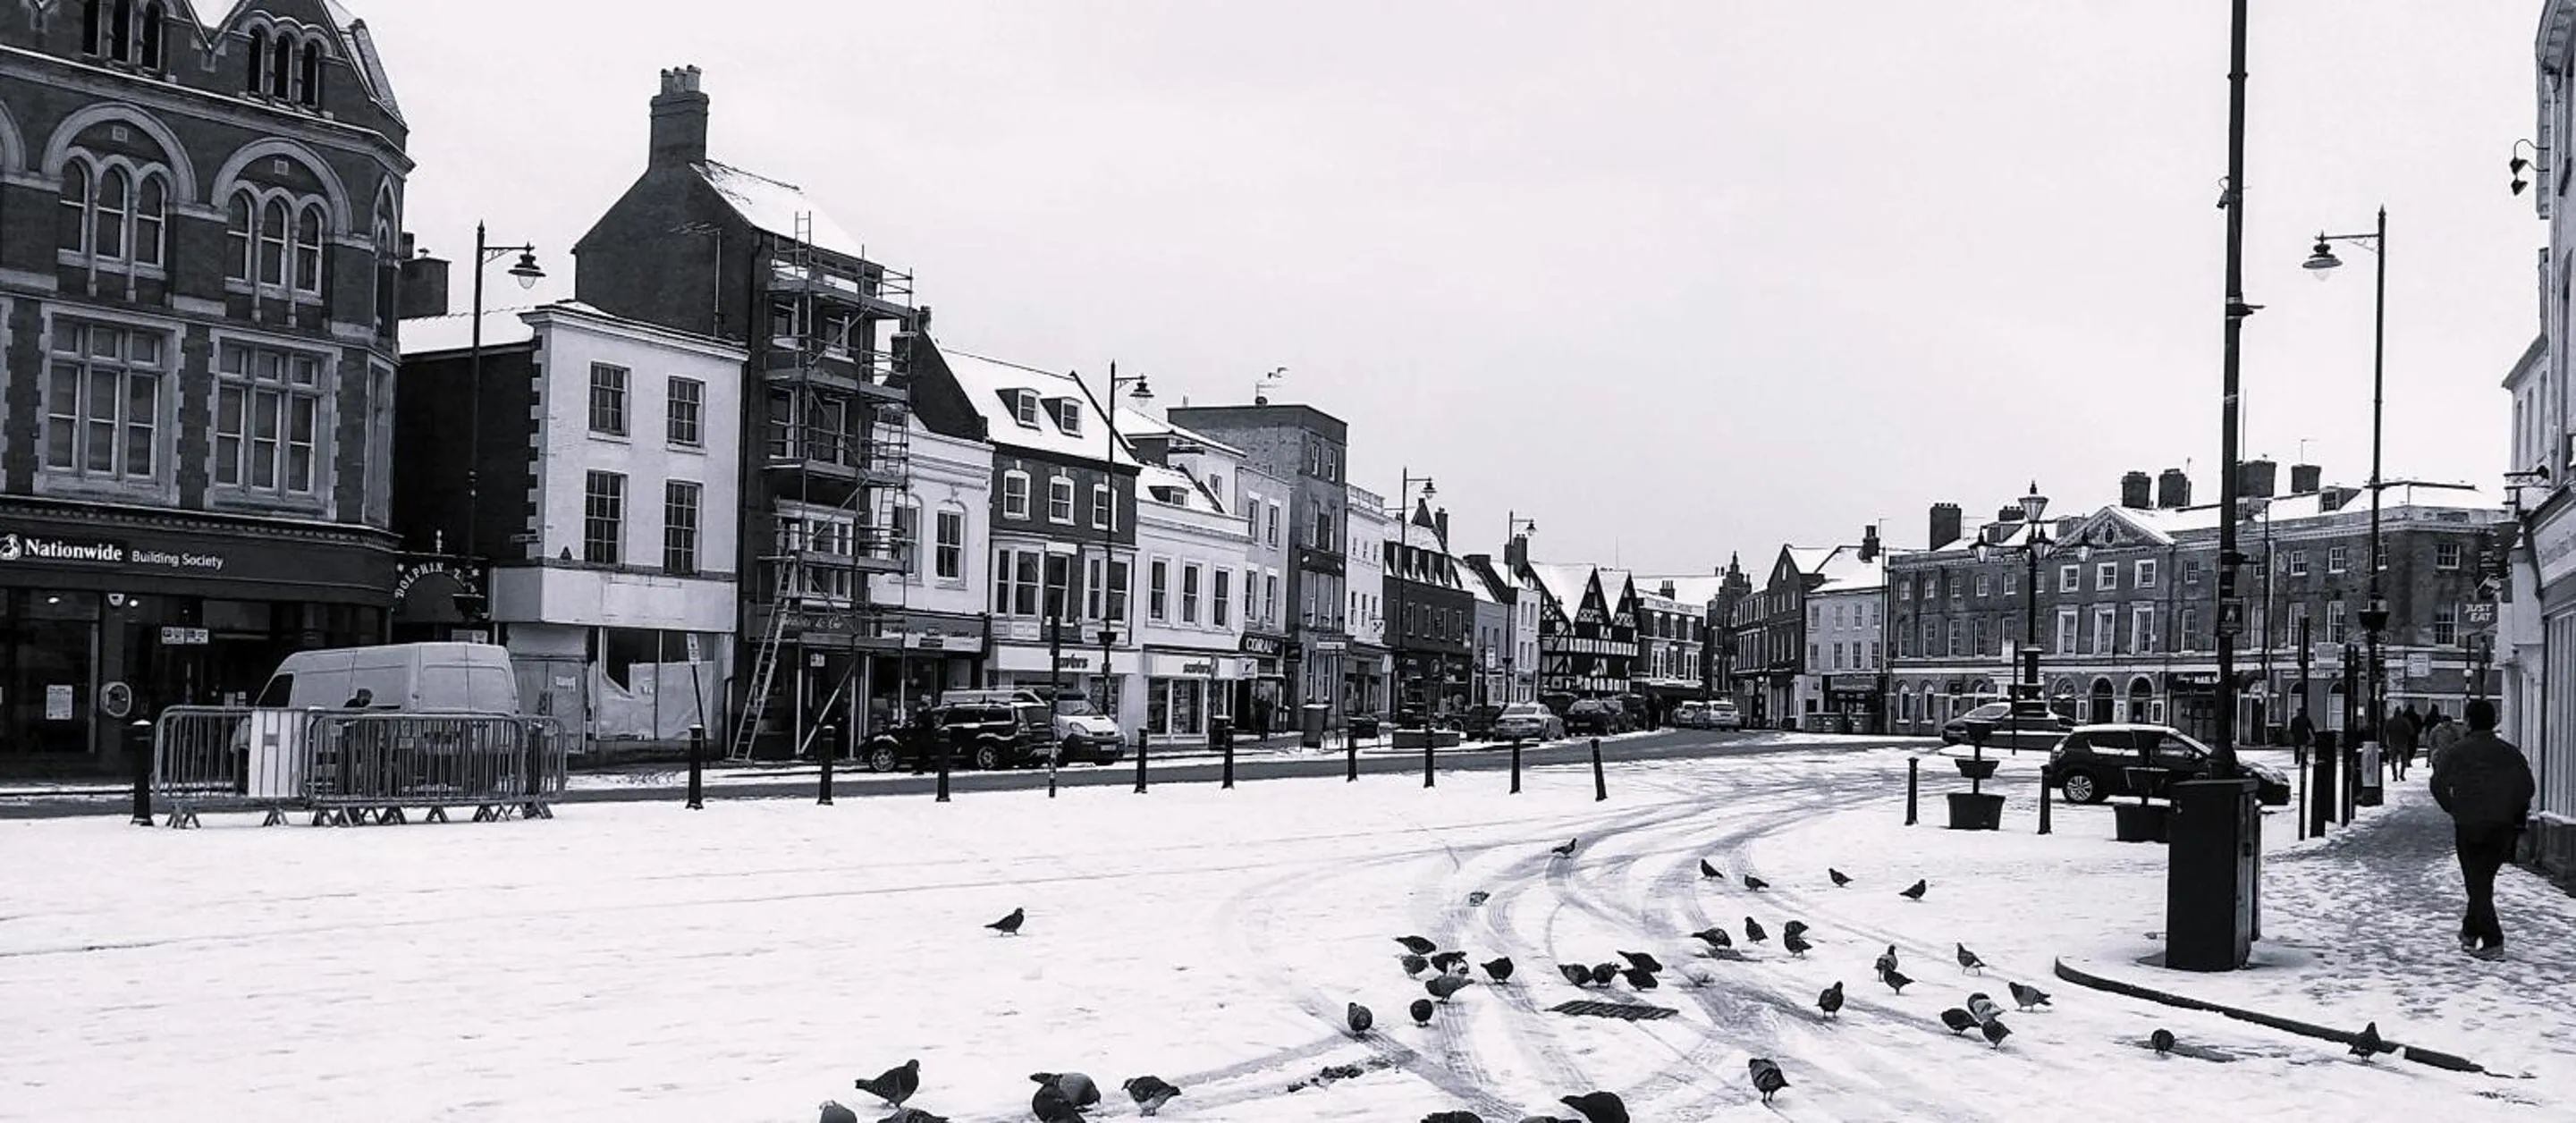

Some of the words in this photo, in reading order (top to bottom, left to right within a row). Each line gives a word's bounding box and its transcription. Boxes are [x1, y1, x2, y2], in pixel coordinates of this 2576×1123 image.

[25, 538, 122, 562] Nationwide
[131, 550, 179, 567] Building
[182, 553, 224, 570] Society
[394, 562, 443, 598] DOLPHIN
[2464, 604, 2493, 613] JUST
[2470, 612, 2492, 622] EAT
[1246, 637, 1273, 654] CORAL
